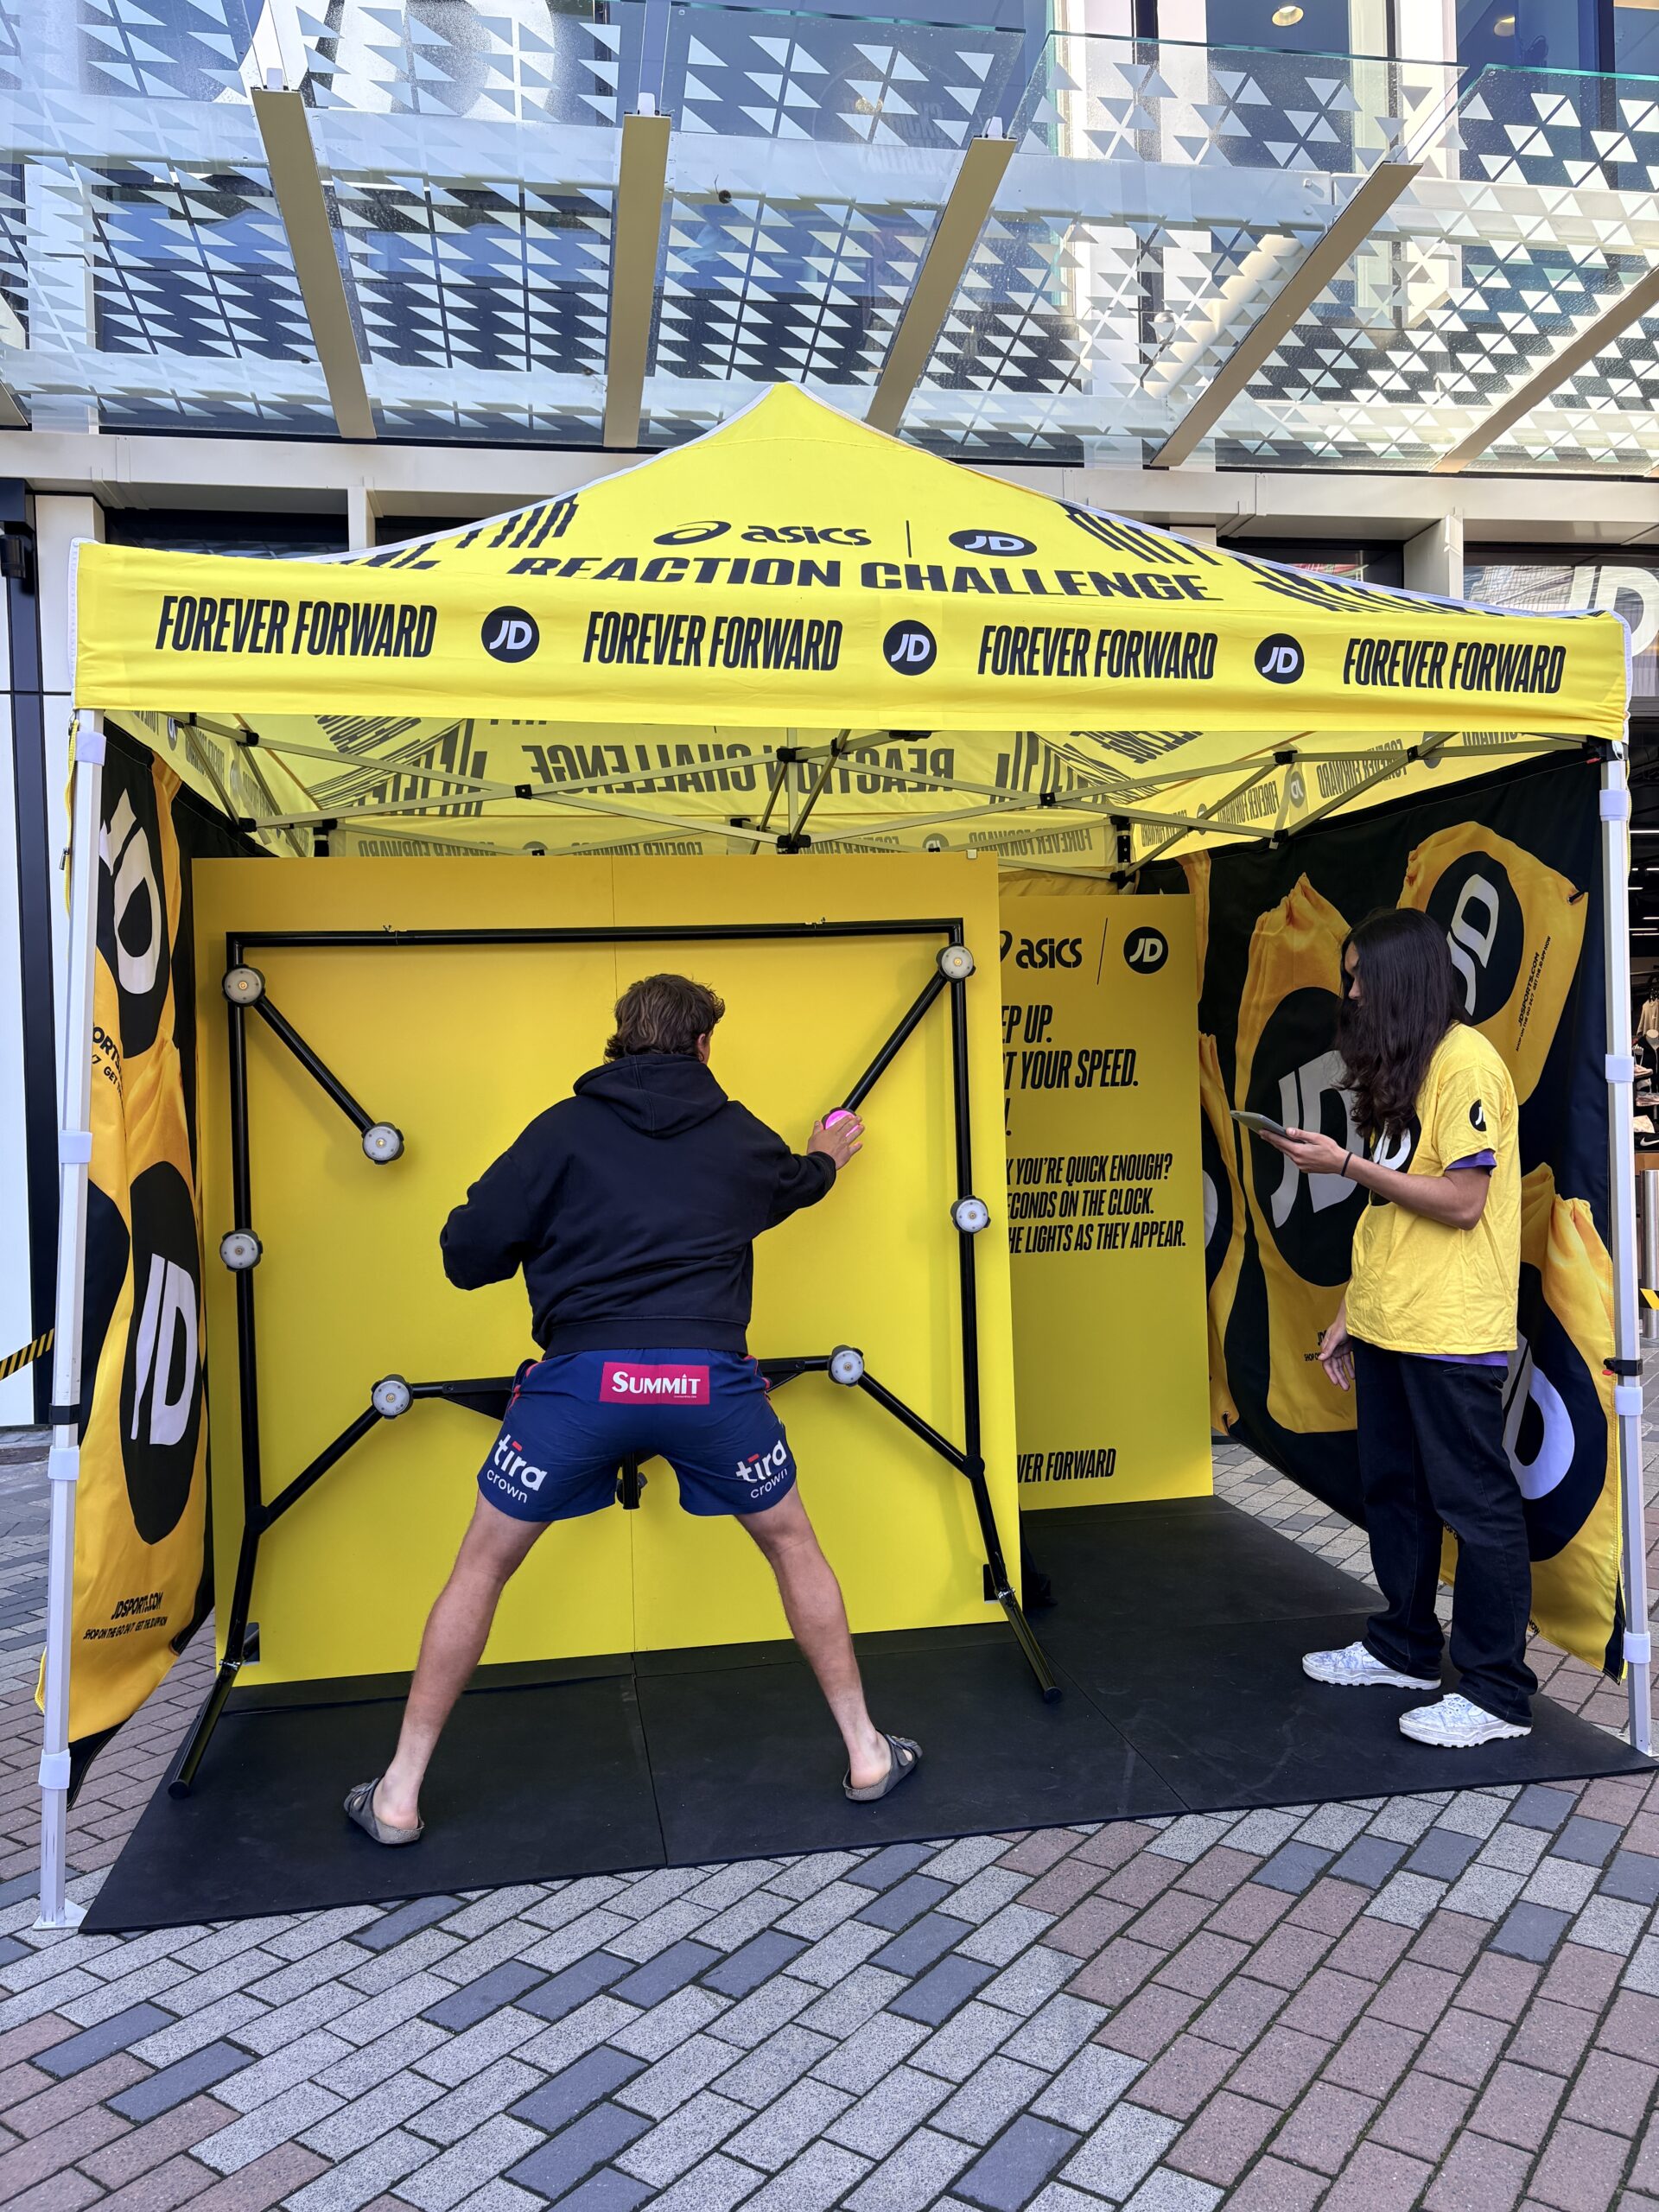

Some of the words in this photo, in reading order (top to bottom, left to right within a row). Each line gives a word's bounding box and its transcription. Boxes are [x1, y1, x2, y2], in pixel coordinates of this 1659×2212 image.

[741, 525, 872, 546] asics
[964, 535, 1025, 550] JD
[506, 556, 841, 588] REACTION
[861, 562, 1224, 601] CHALLENGE
[156, 595, 290, 654] FOREVER
[291, 601, 437, 658] FORWARD
[489, 620, 532, 651] JD
[583, 611, 707, 667] FOREVER
[708, 615, 843, 671] FORWARD
[890, 633, 931, 663] JD
[977, 625, 1090, 677] FOREVER
[1094, 629, 1218, 680] FORWARD
[1262, 646, 1299, 674] JD
[1343, 638, 1448, 690] FOREVER
[1448, 641, 1567, 694] FORWARD
[1015, 938, 1083, 969] asics
[1129, 938, 1163, 963] JD
[1518, 951, 1540, 1027] JDSPORTS.COM
[1024, 1005, 1053, 1043] UP.
[1020, 1050, 1072, 1090] YOUR
[1075, 1048, 1139, 1088] SPEED.
[1016, 1156, 1065, 1185] YOU'RE
[1065, 1154, 1109, 1186] QUICK
[1109, 1153, 1173, 1181] ENOUGH?
[1058, 1190, 1079, 1217] ON
[1083, 1189, 1107, 1217] THE
[1107, 1187, 1154, 1215] CLOCK.
[1025, 1224, 1073, 1253] LIGHTS
[1074, 1223, 1094, 1251] AS
[1096, 1222, 1131, 1250] THEY
[1130, 1220, 1186, 1249] APPEAR.
[612, 1370, 701, 1395] SUMMIT
[494, 1433, 548, 1491] tira
[735, 1440, 787, 1484] tira
[1045, 1448, 1117, 1482] FORWARD
[486, 1470, 528, 1503] crown
[750, 1468, 788, 1499] crown
